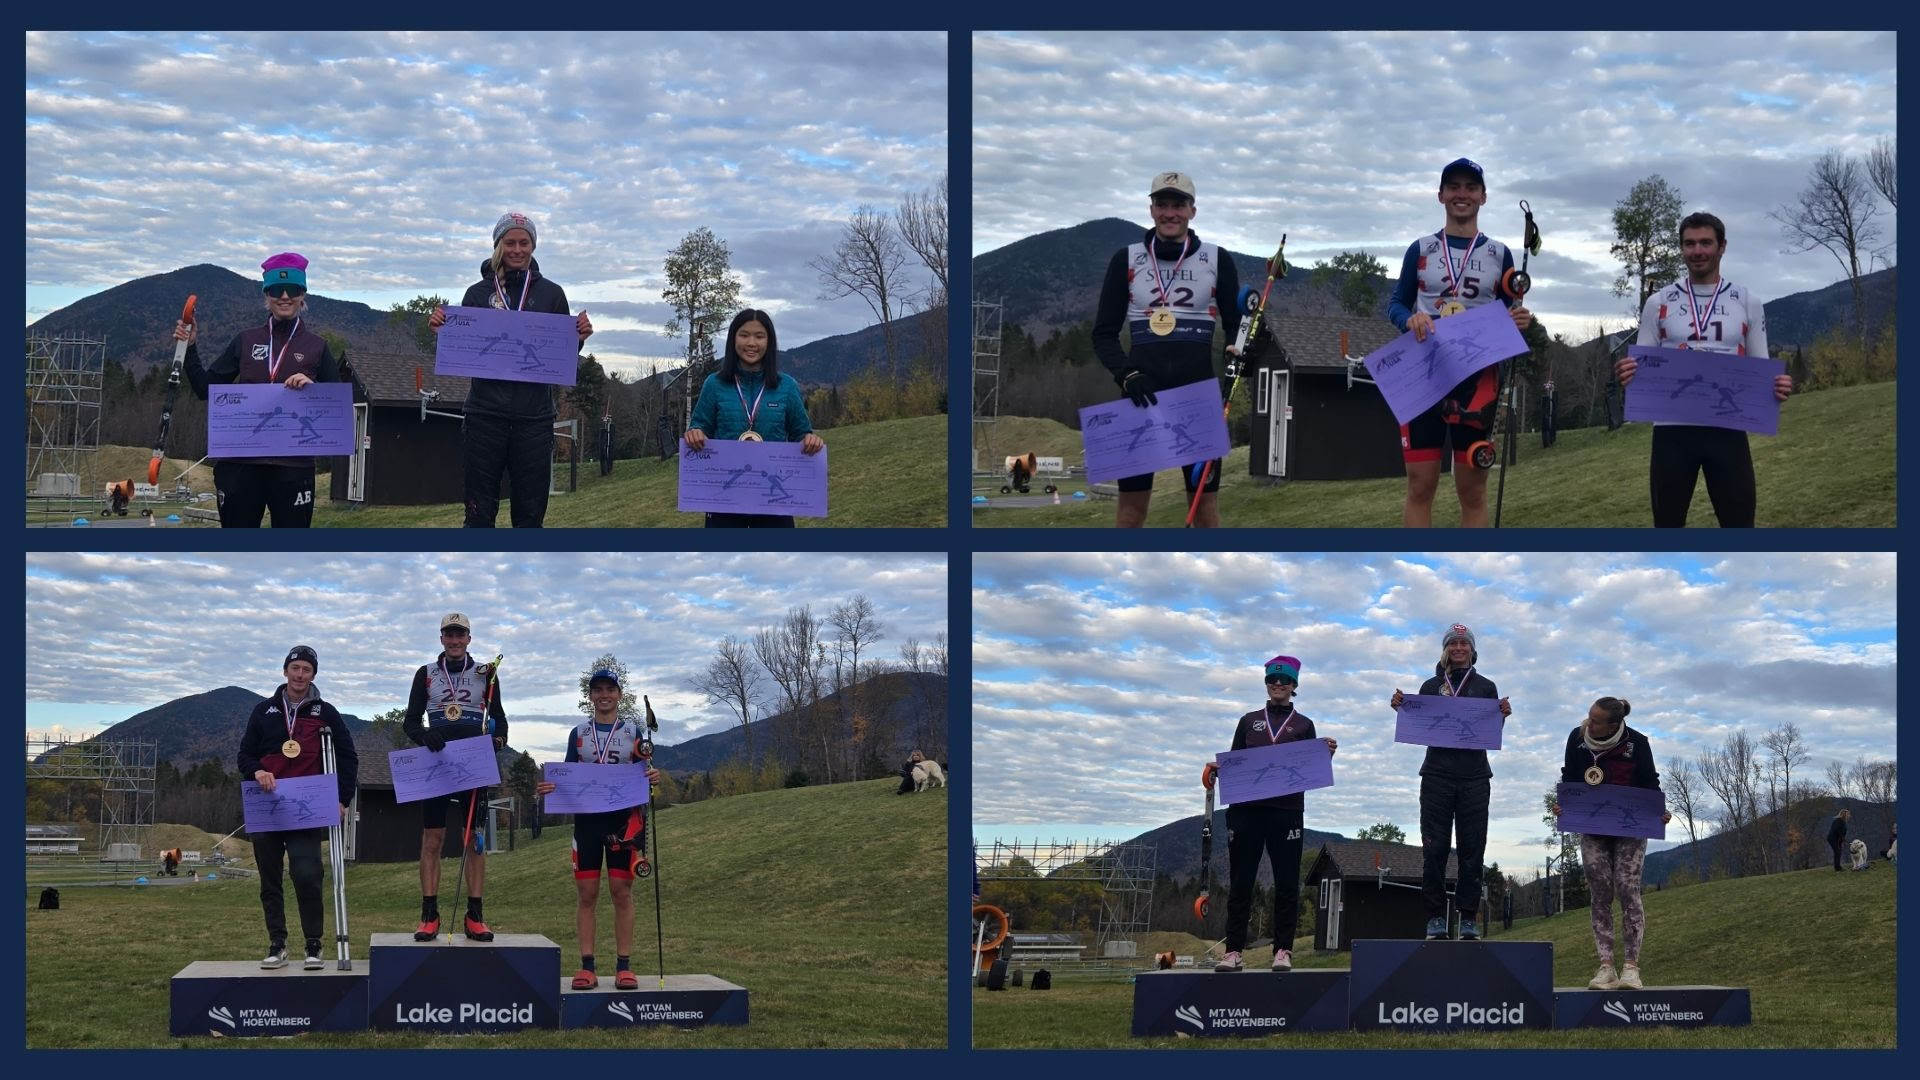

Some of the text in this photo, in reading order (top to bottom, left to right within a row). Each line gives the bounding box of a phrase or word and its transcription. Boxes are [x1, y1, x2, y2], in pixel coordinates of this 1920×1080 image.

[1440, 276, 1480, 299] 25
[1149, 287, 1194, 307] 22
[293, 490, 311, 506] AB
[441, 689, 471, 702] 22
[396, 1002, 533, 1023] Lake Placid
[637, 1003, 672, 1012] MT VAN
[1633, 1003, 1670, 1012] MT VAN
[240, 1009, 277, 1018] MT VAN
[640, 1011, 704, 1020] HOEVENBERG
[1209, 1008, 1250, 1018] MT VAN
[1379, 1002, 1524, 1024] Lake Placid
[1637, 1012, 1704, 1021] HOEVENBERG
[243, 1017, 311, 1027] HOEVENBERG
[1212, 1017, 1286, 1028] HOEVENBERG
